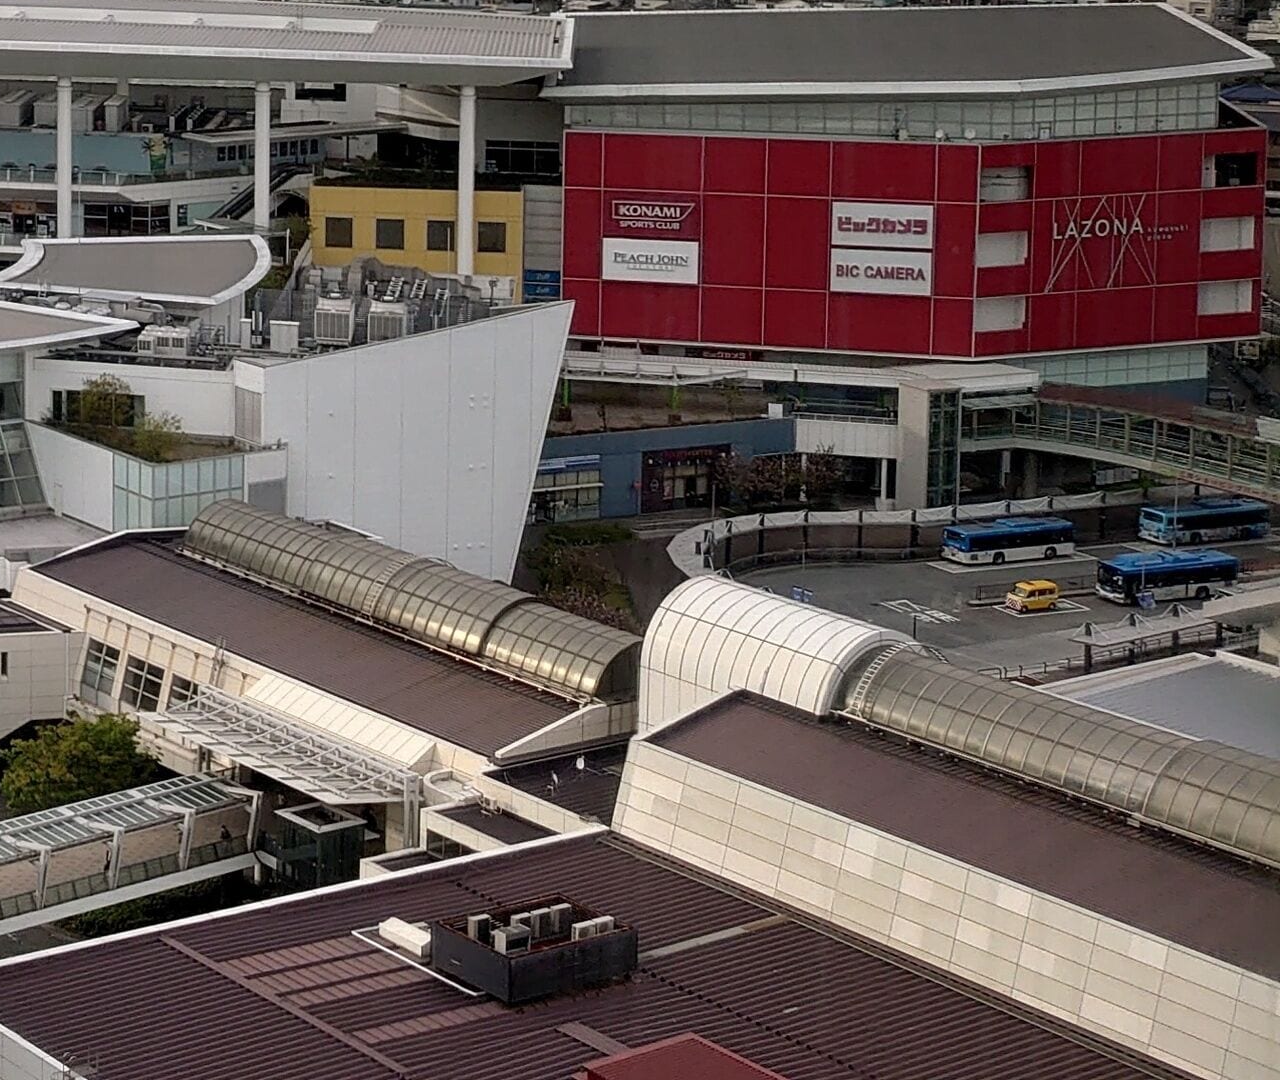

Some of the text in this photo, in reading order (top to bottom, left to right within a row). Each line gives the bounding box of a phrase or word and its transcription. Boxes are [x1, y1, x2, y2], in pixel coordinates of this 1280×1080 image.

[618, 205, 681, 218] KONAMI
[619, 220, 680, 230] SPORTS CLUB
[837, 216, 928, 235] ビックカメラ
[1053, 218, 1144, 240] LAZONA
[613, 252, 689, 267] PEACH JOHN
[836, 264, 927, 281] BIC CAMERA
